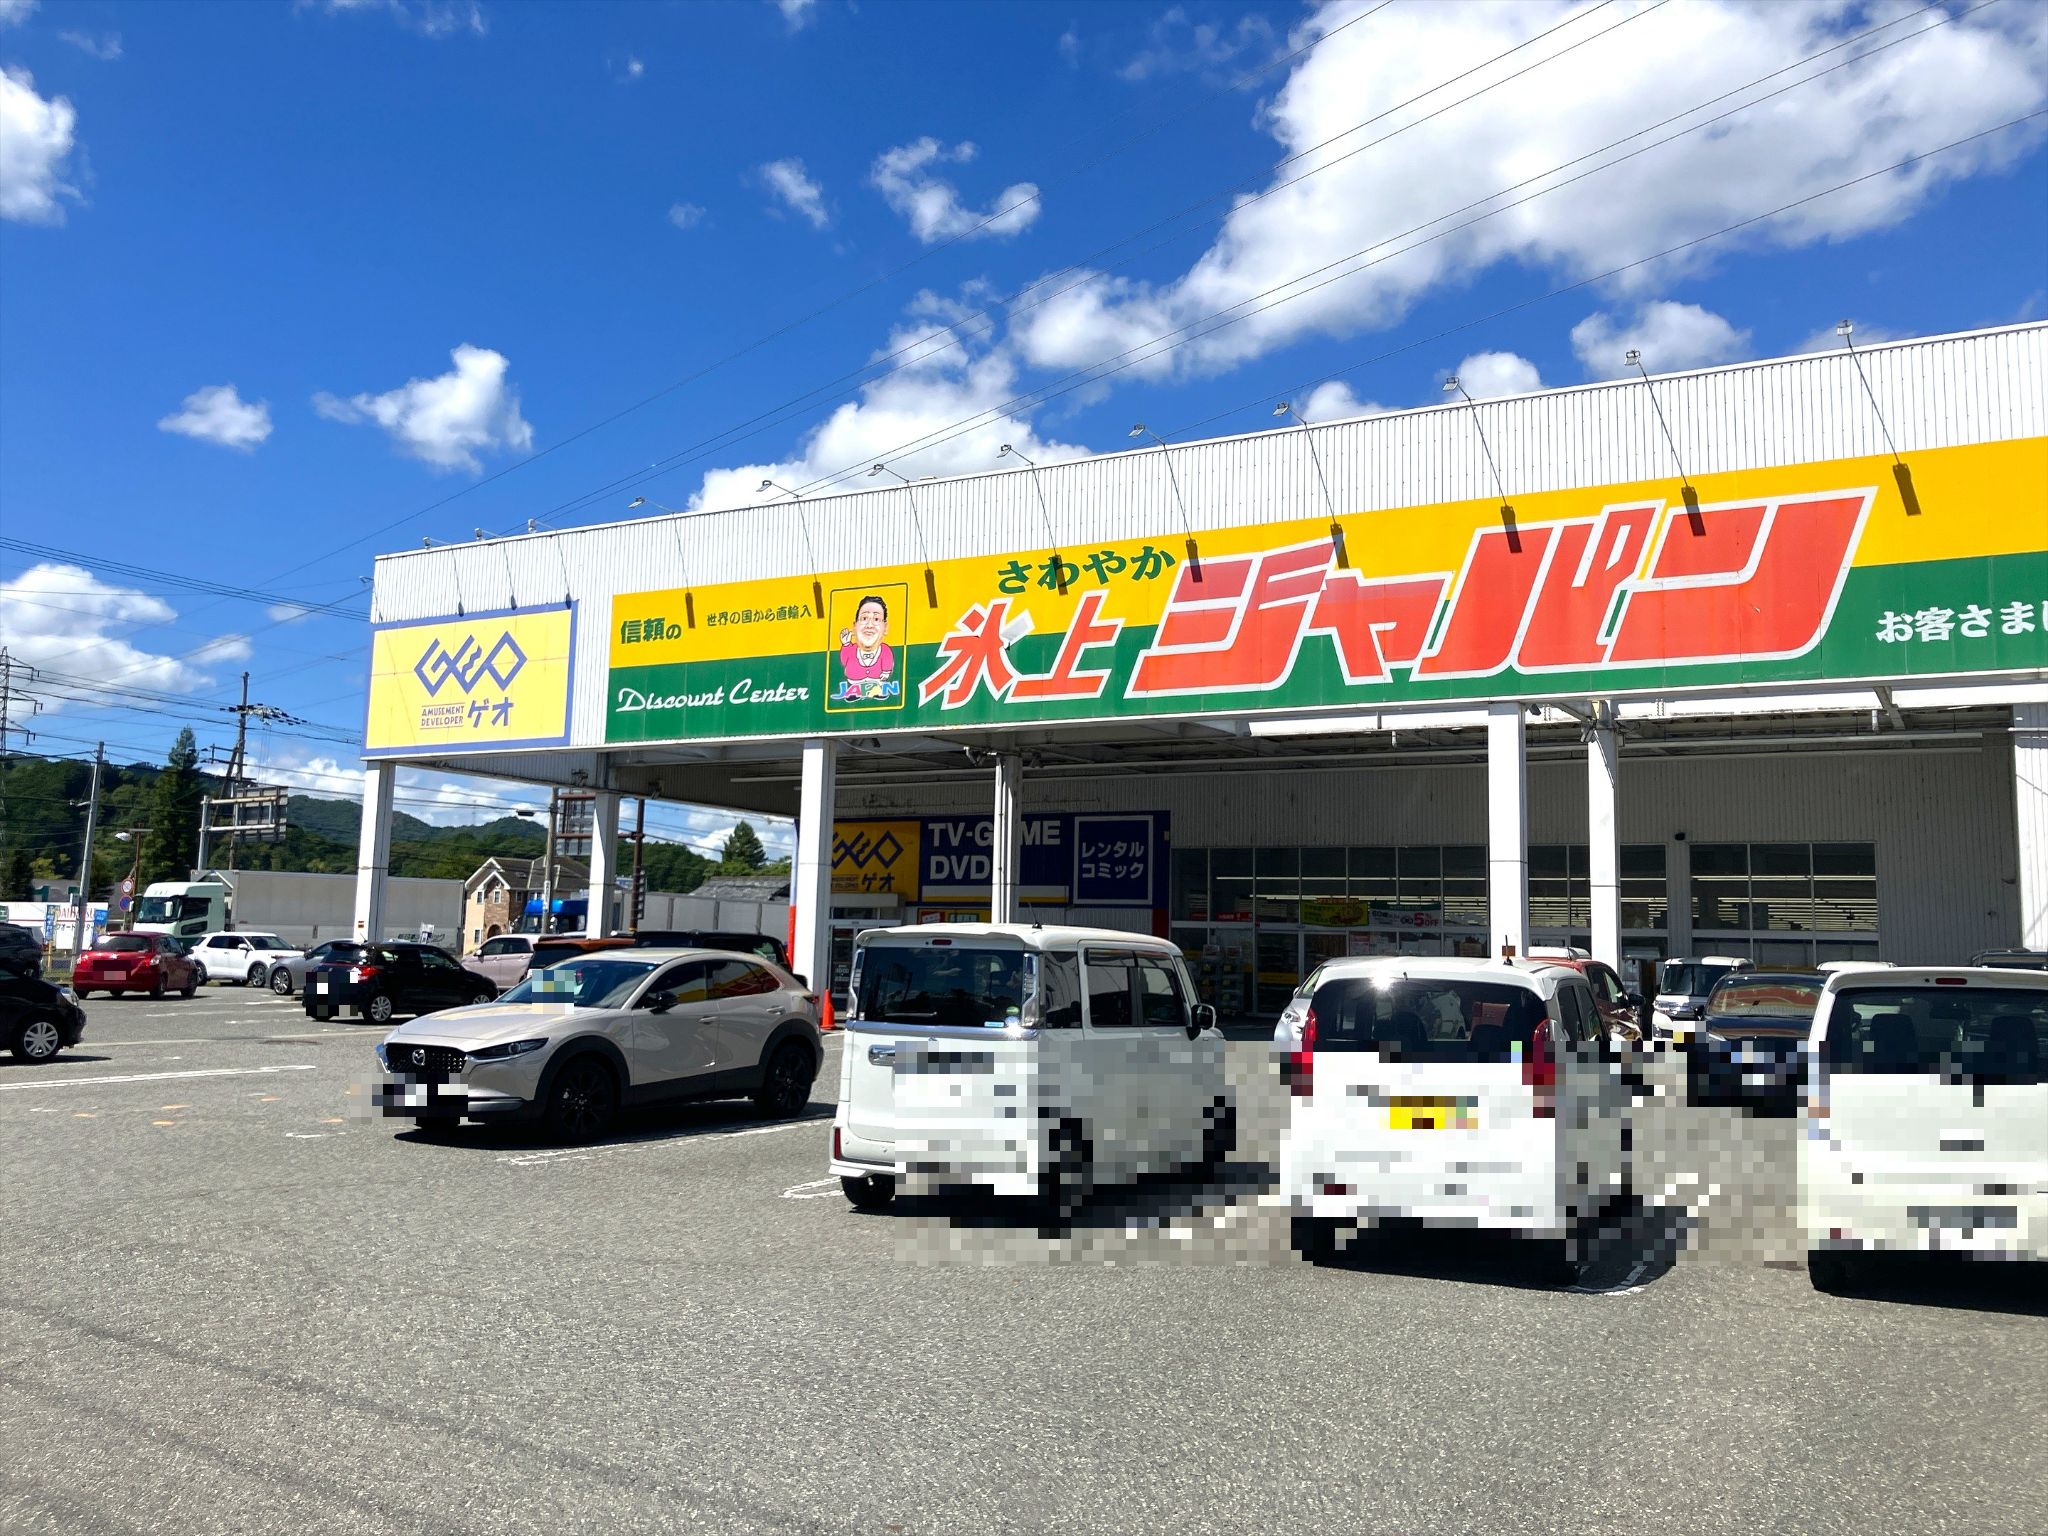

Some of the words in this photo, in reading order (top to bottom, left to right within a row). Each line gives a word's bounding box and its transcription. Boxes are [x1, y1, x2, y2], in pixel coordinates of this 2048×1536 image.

[997, 545, 1177, 594] さわやか
[620, 617, 682, 645] 信頼の
[706, 604, 812, 627] 世界の国から直輸入
[414, 630, 528, 698] GEO
[616, 684, 725, 712] Discount
[729, 678, 809, 703] Center
[830, 680, 900, 701] JAPAN
[420, 715, 464, 727] DEVELOPER
[421, 705, 465, 717] AMUSEMENT
[467, 697, 514, 728] ゲオ
[928, 820, 1061, 848] TV-GME
[1081, 841, 1145, 858] レンタル
[929, 855, 991, 880] DVD
[1081, 862, 1145, 879] コミック
[862, 873, 895, 891] ゲオ
[1424, 918, 1439, 927] OFF
